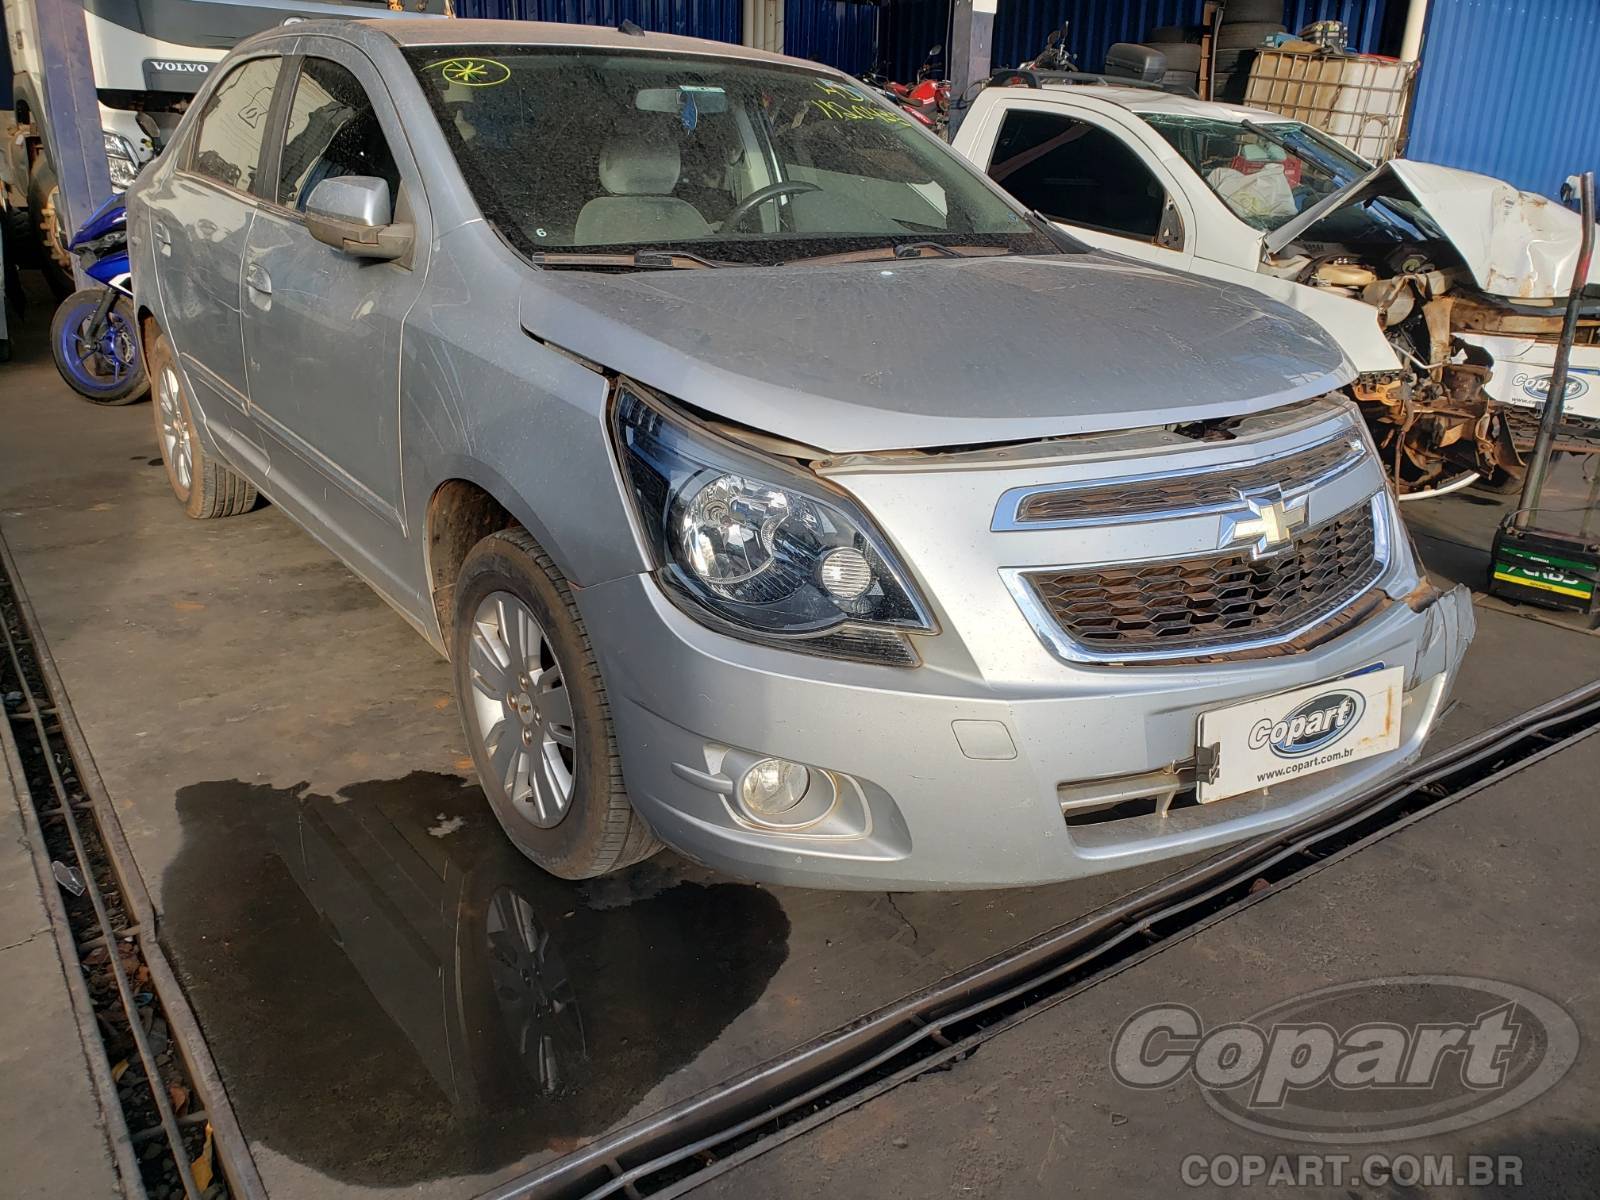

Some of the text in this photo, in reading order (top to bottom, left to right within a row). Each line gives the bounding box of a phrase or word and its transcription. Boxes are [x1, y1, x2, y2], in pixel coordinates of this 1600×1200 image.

[151, 61, 209, 73] VOLVO
[1248, 696, 1353, 750] Copart
[1256, 747, 1354, 783] www.copart.com.br
